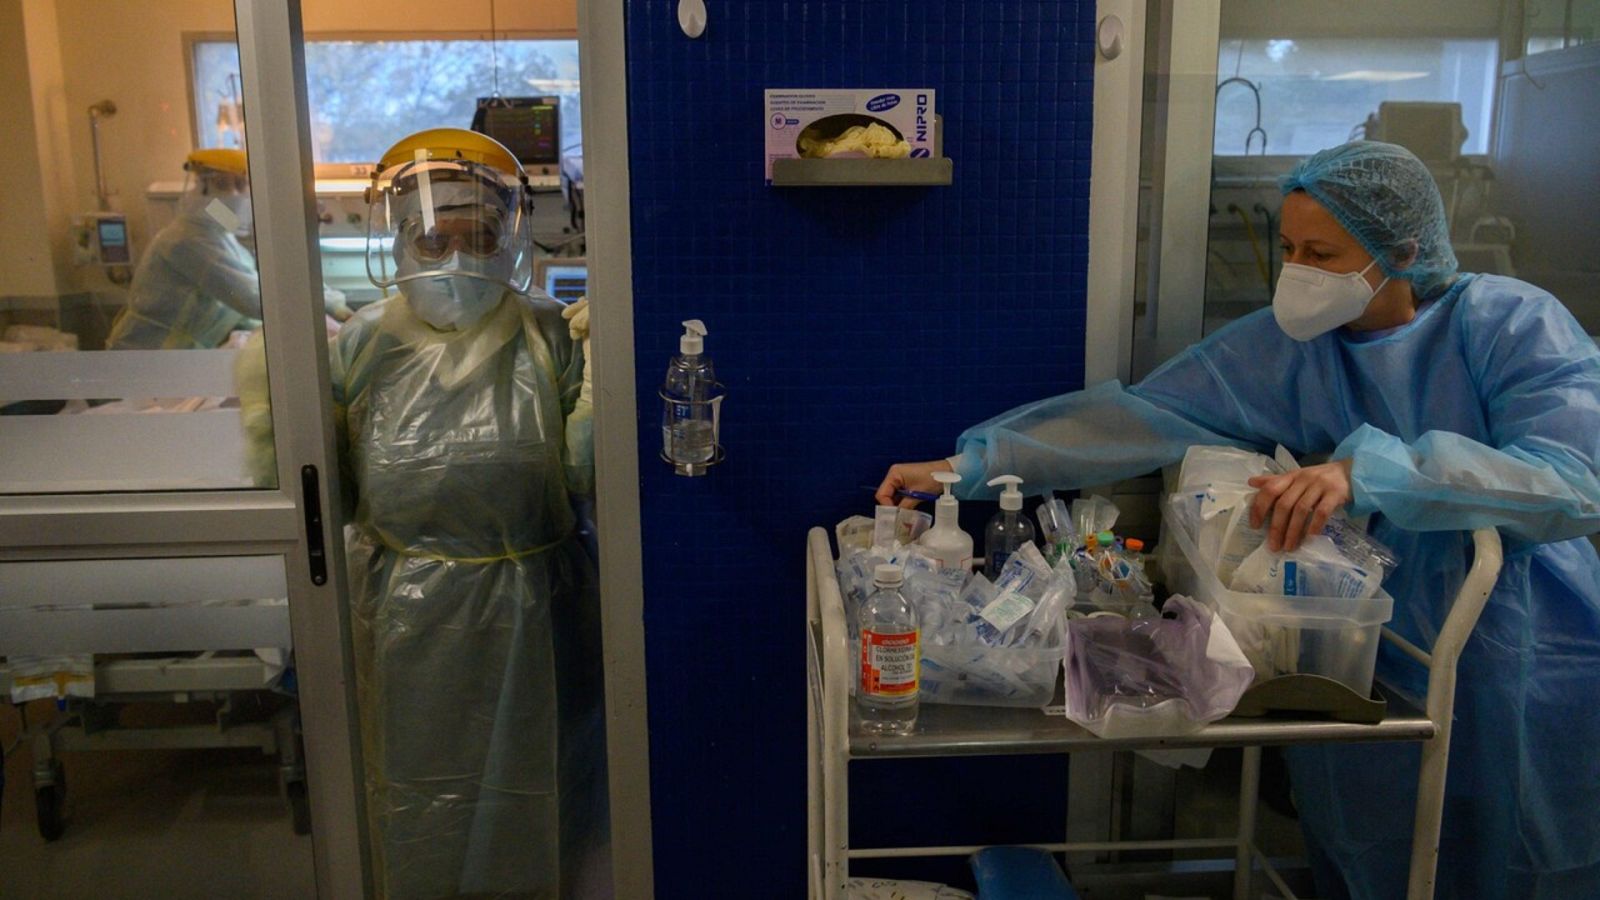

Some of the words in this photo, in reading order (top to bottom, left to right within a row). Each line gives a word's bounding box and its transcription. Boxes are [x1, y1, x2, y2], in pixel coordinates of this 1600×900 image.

[775, 117, 782, 126] M
[916, 94, 927, 142] NIPRO
[881, 664, 905, 672] ALCOHOL
